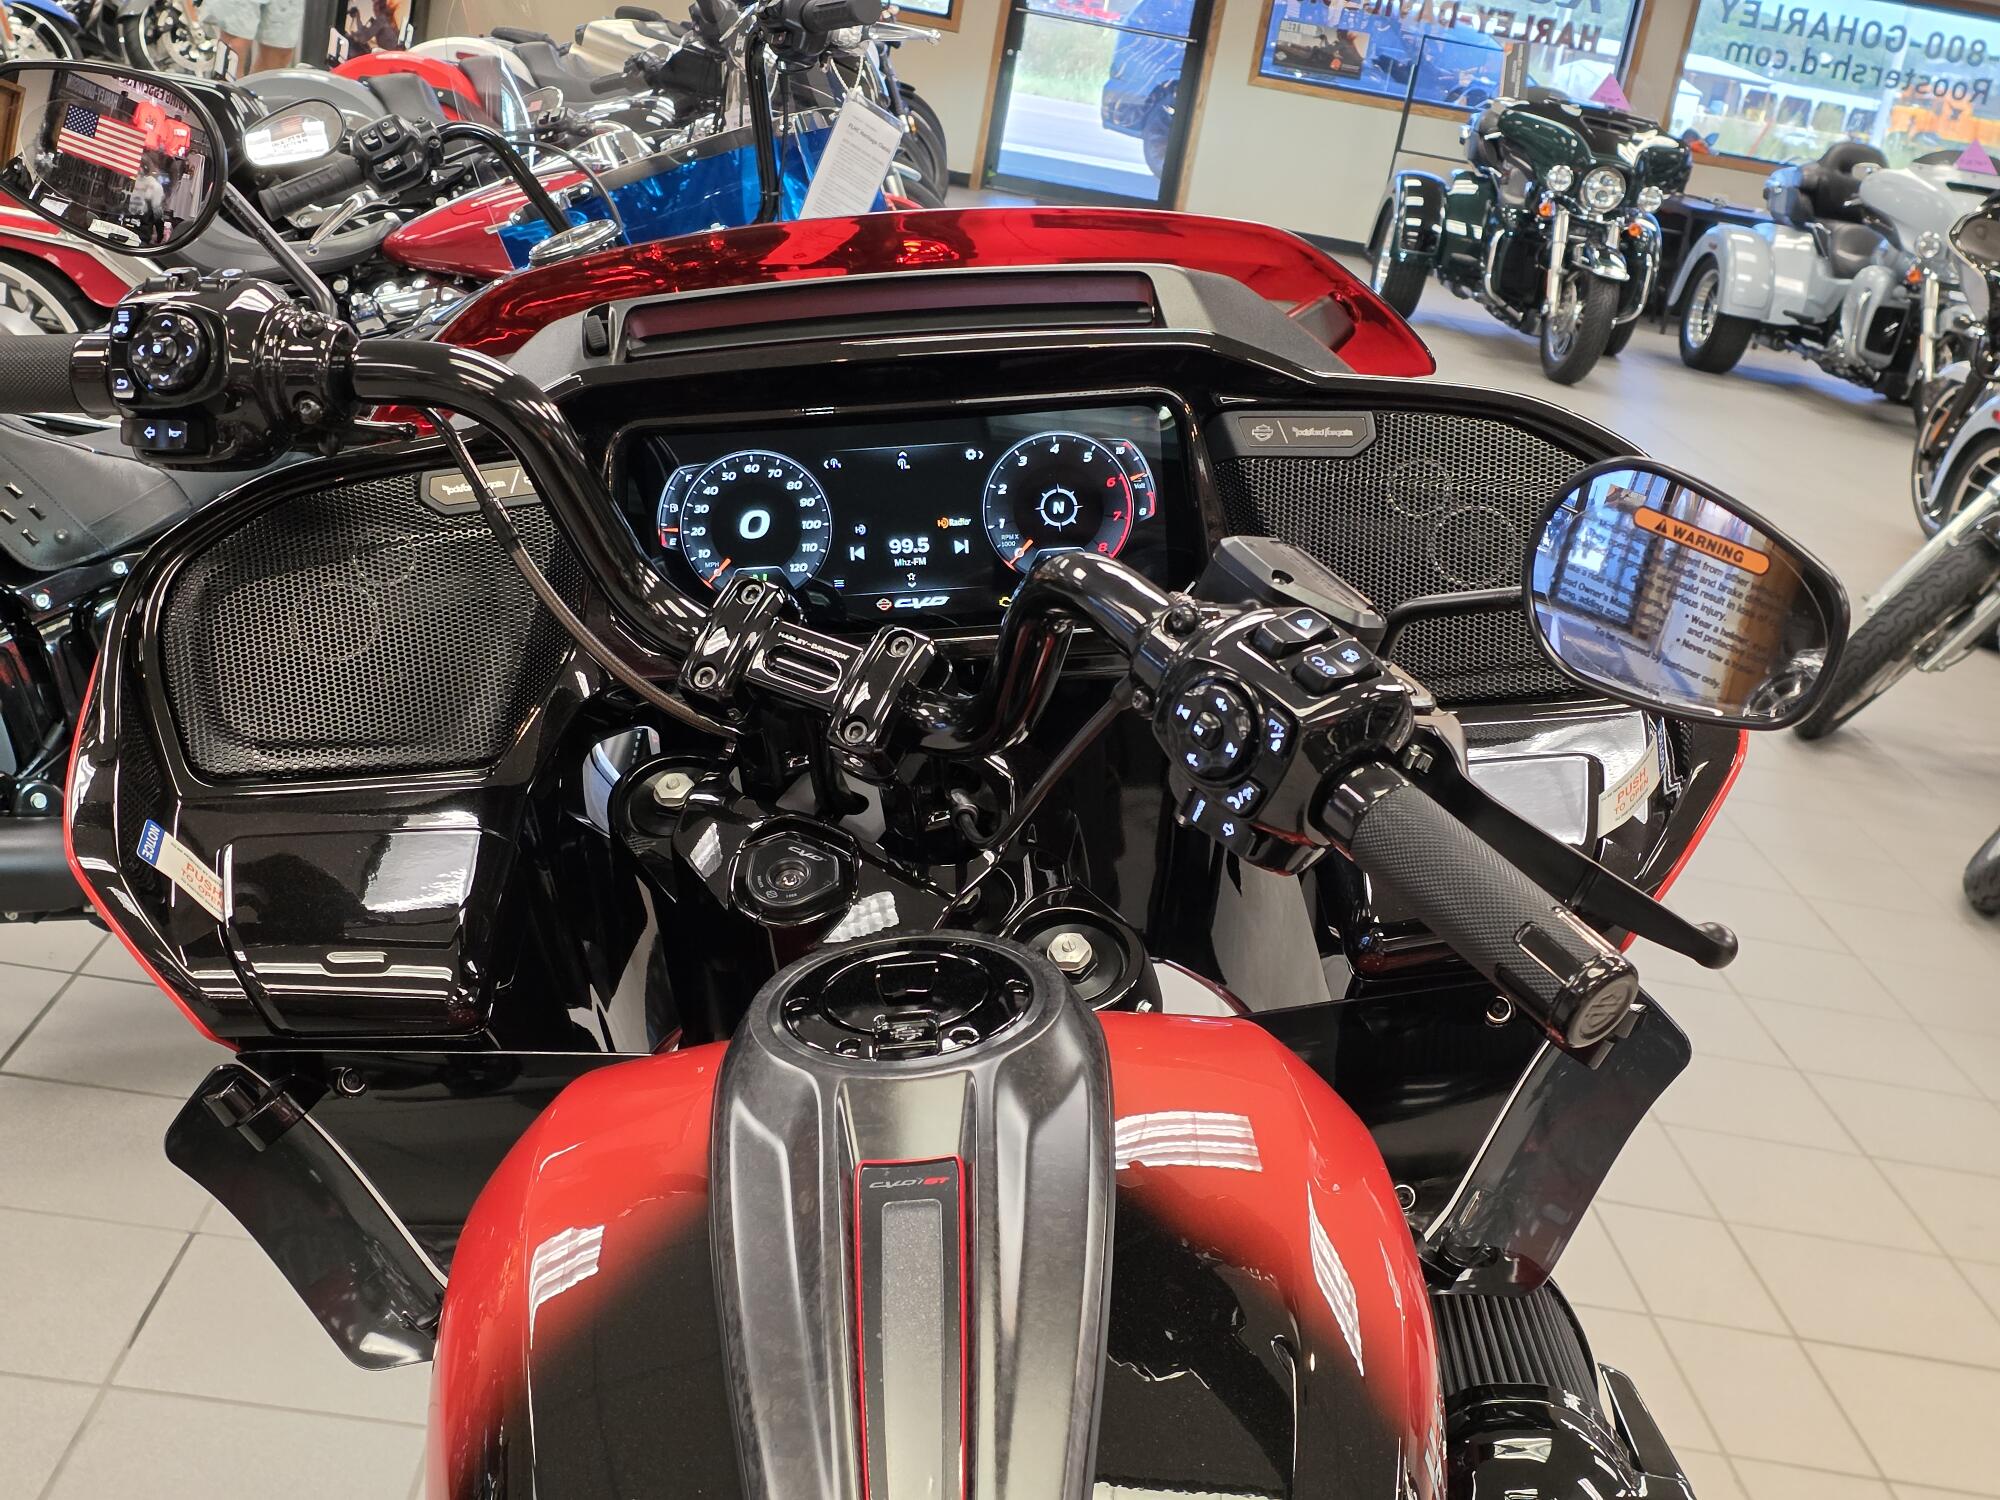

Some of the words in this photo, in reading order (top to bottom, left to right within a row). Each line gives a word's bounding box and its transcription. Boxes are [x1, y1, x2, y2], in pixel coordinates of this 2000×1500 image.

[1050, 443, 1060, 454] 4
[1018, 456, 1028, 466] 3
[1083, 451, 1092, 463] 5
[744, 464, 760, 473] 60
[768, 469, 782, 478] 70
[685, 474, 692, 482] F
[722, 472, 736, 480] 50
[786, 481, 802, 490] 80
[1106, 477, 1116, 487] 6
[703, 486, 718, 495] 40
[998, 484, 1007, 494] 2
[799, 498, 815, 507] 90
[1052, 501, 1065, 514] N
[694, 505, 709, 513] 30
[1113, 511, 1122, 521] 7
[739, 509, 770, 539] 0
[802, 520, 821, 529] 100
[999, 518, 1005, 528] 1
[691, 527, 705, 536] 20
[802, 543, 818, 552] 110
[889, 537, 930, 554] 99.5
[1098, 542, 1108, 552] 8
[1672, 524, 1744, 564] WARNING
[699, 549, 710, 558] 10
[790, 563, 808, 572] 120
[894, 557, 926, 567] Mhz-FM
[1702, 562, 1724, 576] from
[1723, 570, 1749, 587] other
[1576, 582, 1609, 601] Owner's
[1699, 575, 1716, 588] and
[1717, 581, 1744, 599] brake
[1578, 595, 1604, 611] adding
[1699, 589, 1726, 605] result
[1726, 600, 1736, 610] in
[1699, 603, 1728, 623] injury.
[1690, 615, 1713, 630] Wear
[1712, 625, 1719, 633] a
[1686, 626, 1703, 638] and
[778, 632, 850, 660] HARLEY-DAVIDSON
[1680, 639, 1706, 655] Never
[1706, 649, 1723, 662] tow
[1593, 626, 1605, 636] To
[1605, 632, 1616, 641] be
[1615, 636, 1651, 657] removed
[1650, 651, 1662, 663] by
[1661, 657, 1701, 679] customer
[1617, 767, 1646, 803] PUSH
[1616, 803, 1626, 814] TO
[142, 824, 160, 860] NOTICE
[788, 847, 824, 861] CVO
[181, 869, 194, 883] TO
[186, 863, 224, 899] PUSH
